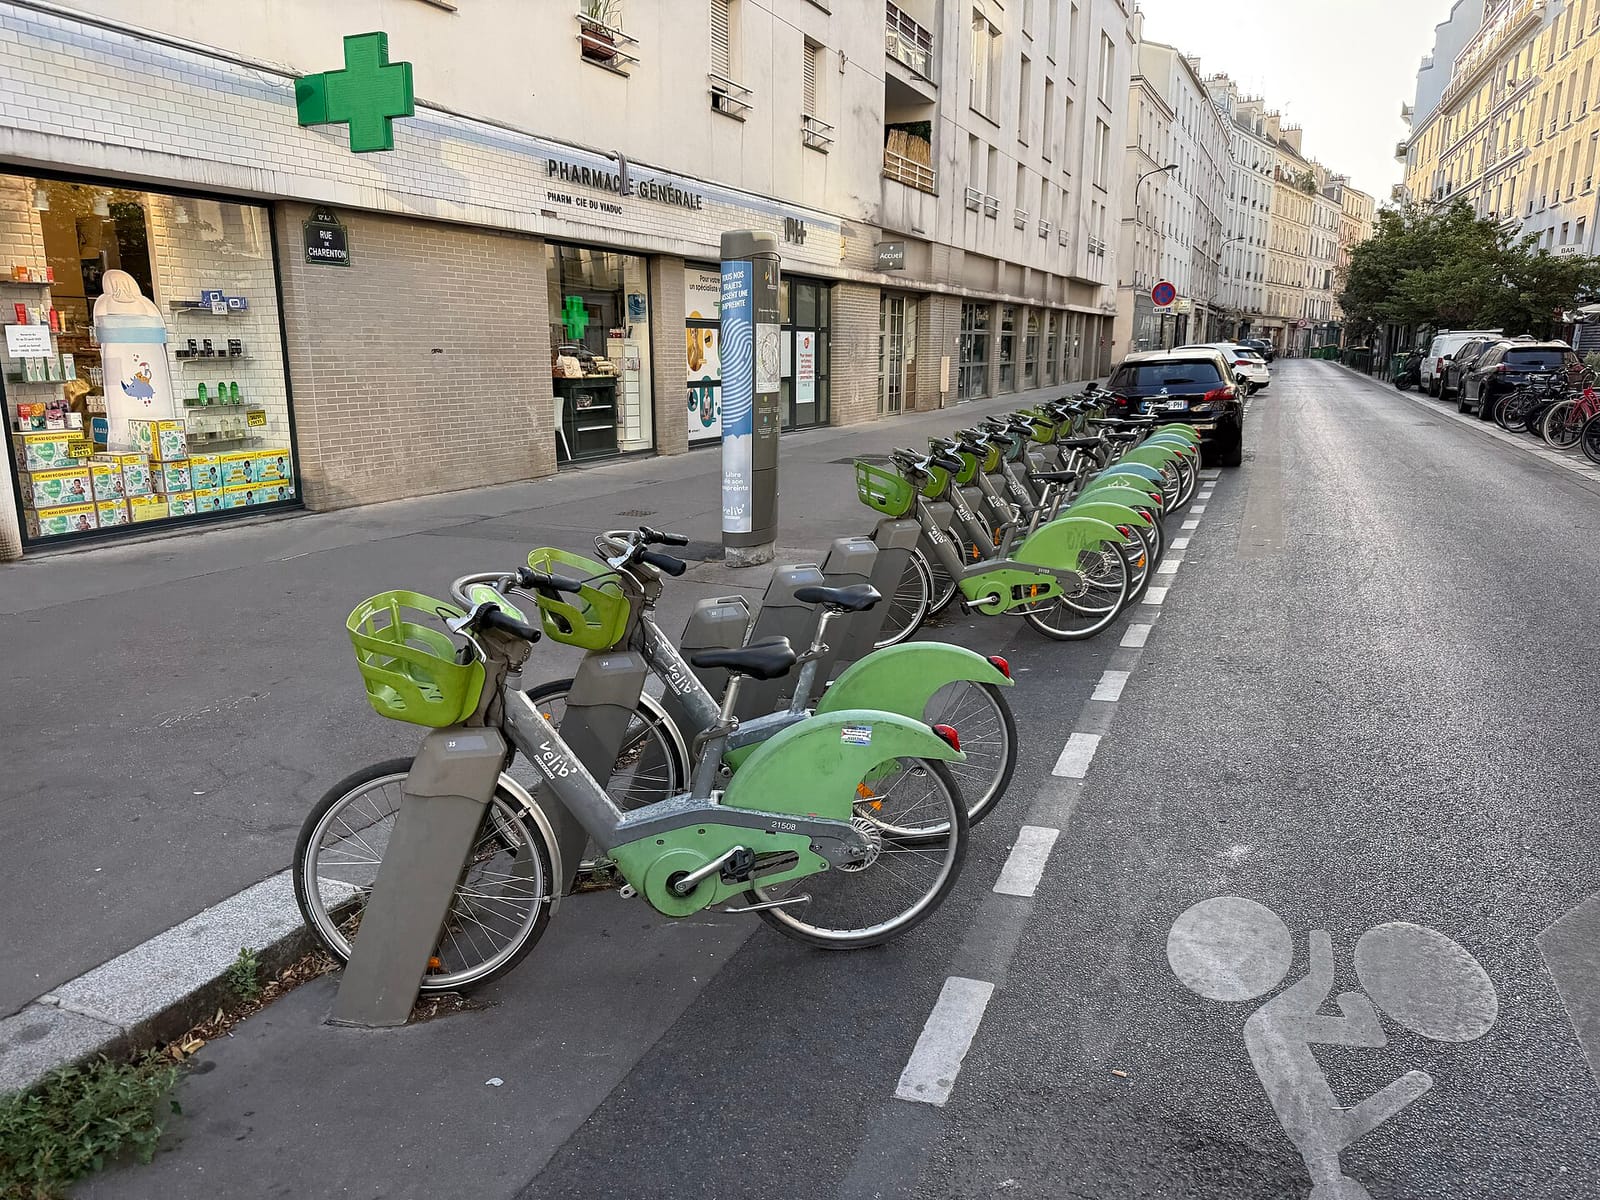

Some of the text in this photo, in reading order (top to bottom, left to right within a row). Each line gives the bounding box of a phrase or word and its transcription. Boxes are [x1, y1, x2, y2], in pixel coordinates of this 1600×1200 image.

[548, 159, 702, 210] PHARMACE GÉNÉRALE
[547, 191, 623, 215] PHARM CIE DU VIADUC
[320, 231, 332, 240] RUE
[308, 247, 346, 259] CHARENTON
[879, 251, 903, 260] Accueil
[733, 271, 744, 279] NOS
[724, 281, 742, 291] TRAJETS
[721, 289, 748, 301] ISSENT UNE
[721, 299, 746, 311] MPREINTE
[771, 820, 797, 831] 21508
